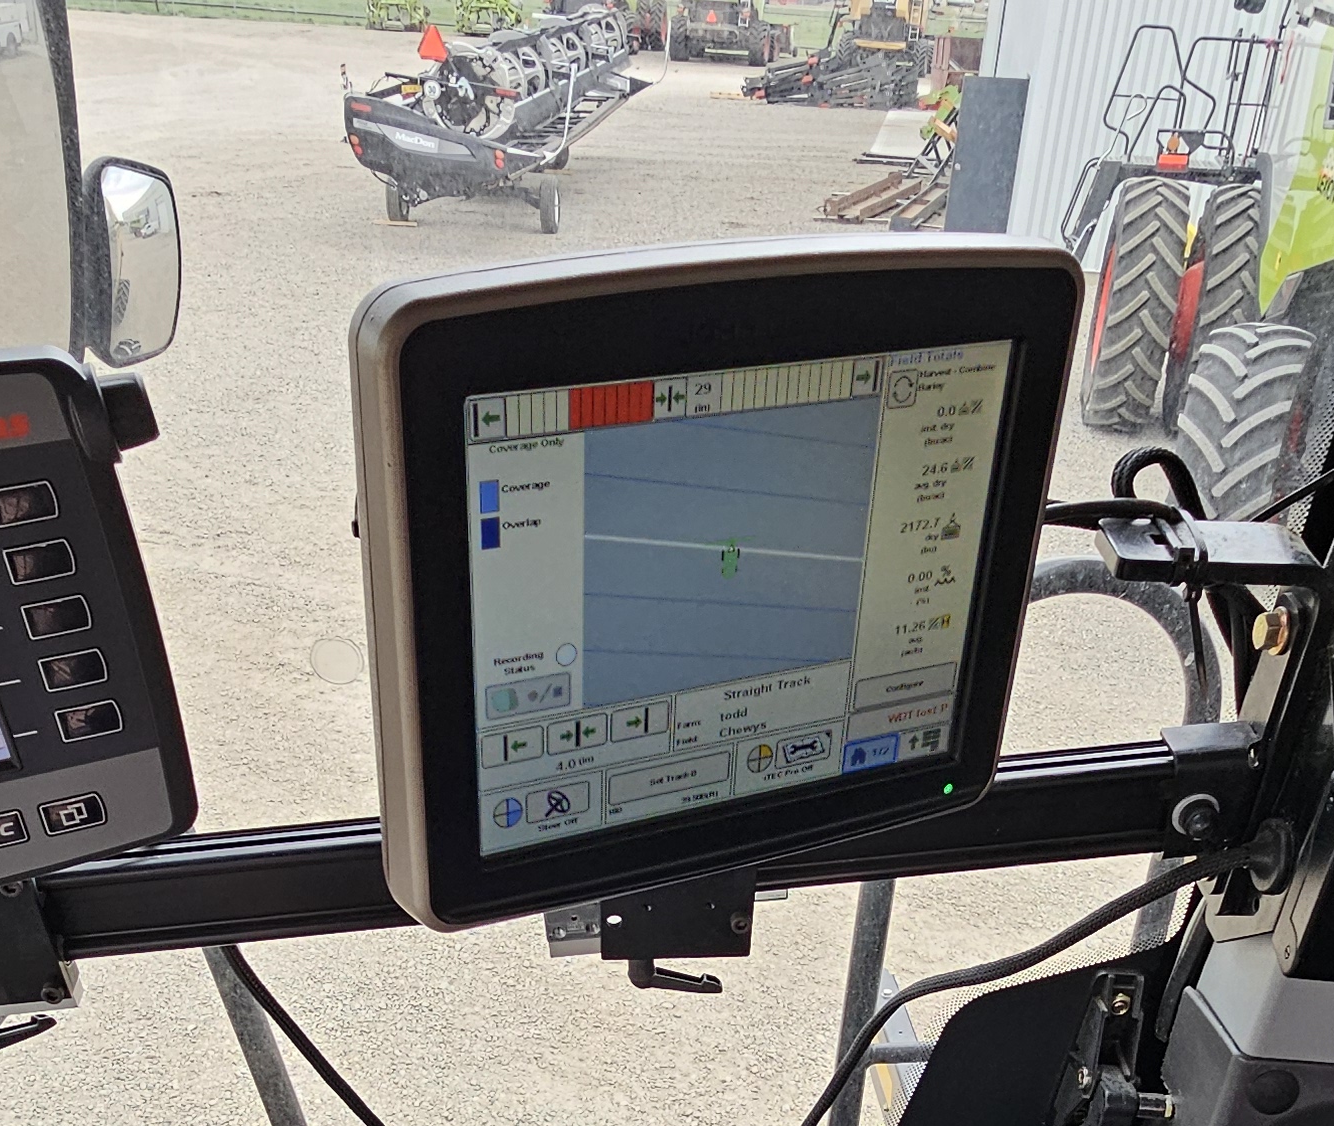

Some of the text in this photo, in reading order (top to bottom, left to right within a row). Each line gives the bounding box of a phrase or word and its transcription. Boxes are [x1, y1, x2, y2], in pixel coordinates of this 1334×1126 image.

[394, 131, 436, 150] MacDon
[694, 382, 712, 397] 29
[937, 405, 956, 418] 0.0
[488, 436, 565, 454] Coverage Only
[921, 461, 948, 477] 24.6
[501, 479, 551, 494] Coverage
[502, 516, 542, 531] Overlap
[899, 517, 942, 534] 2172.7
[894, 620, 926, 636] 11.26
[493, 651, 545, 667] Recording
[504, 664, 536, 677] Status
[723, 675, 811, 701] Straight Track
[720, 706, 748, 722] todd
[719, 721, 767, 738] Chewys
[555, 758, 575, 772] 4.0
